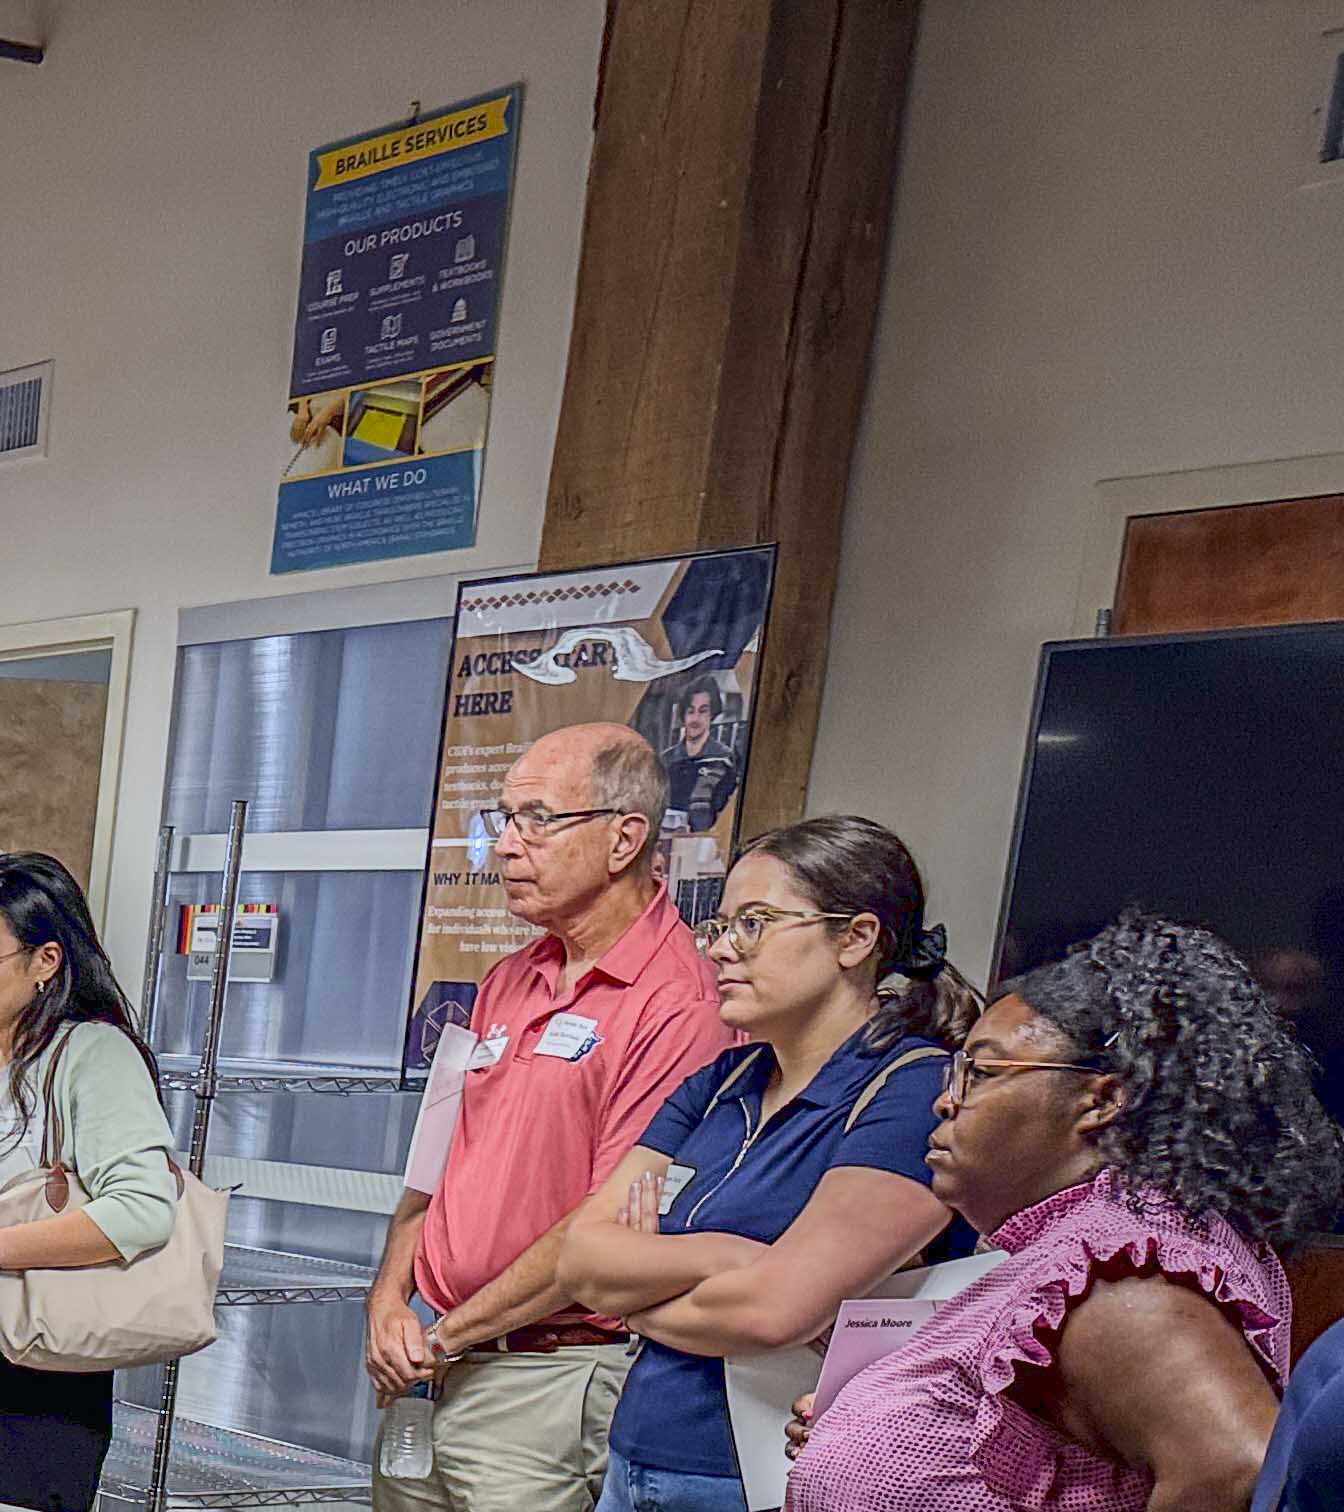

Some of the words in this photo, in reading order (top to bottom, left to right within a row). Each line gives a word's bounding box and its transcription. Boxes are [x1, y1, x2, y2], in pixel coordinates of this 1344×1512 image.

[335, 138, 401, 175] BRAILLE
[405, 113, 488, 153] SERVICES
[344, 235, 377, 257] OUR
[381, 210, 463, 247] PRODUCTS
[369, 275, 425, 297] SUPPLEMENTS
[327, 478, 373, 498] WHAT
[374, 473, 400, 490] WE
[403, 468, 427, 486] DO
[454, 690, 514, 718] HERE
[433, 872, 460, 886] WHY
[464, 872, 479, 885] IT
[845, 1317, 878, 1328] Jessica
[880, 1318, 912, 1328] Moore
